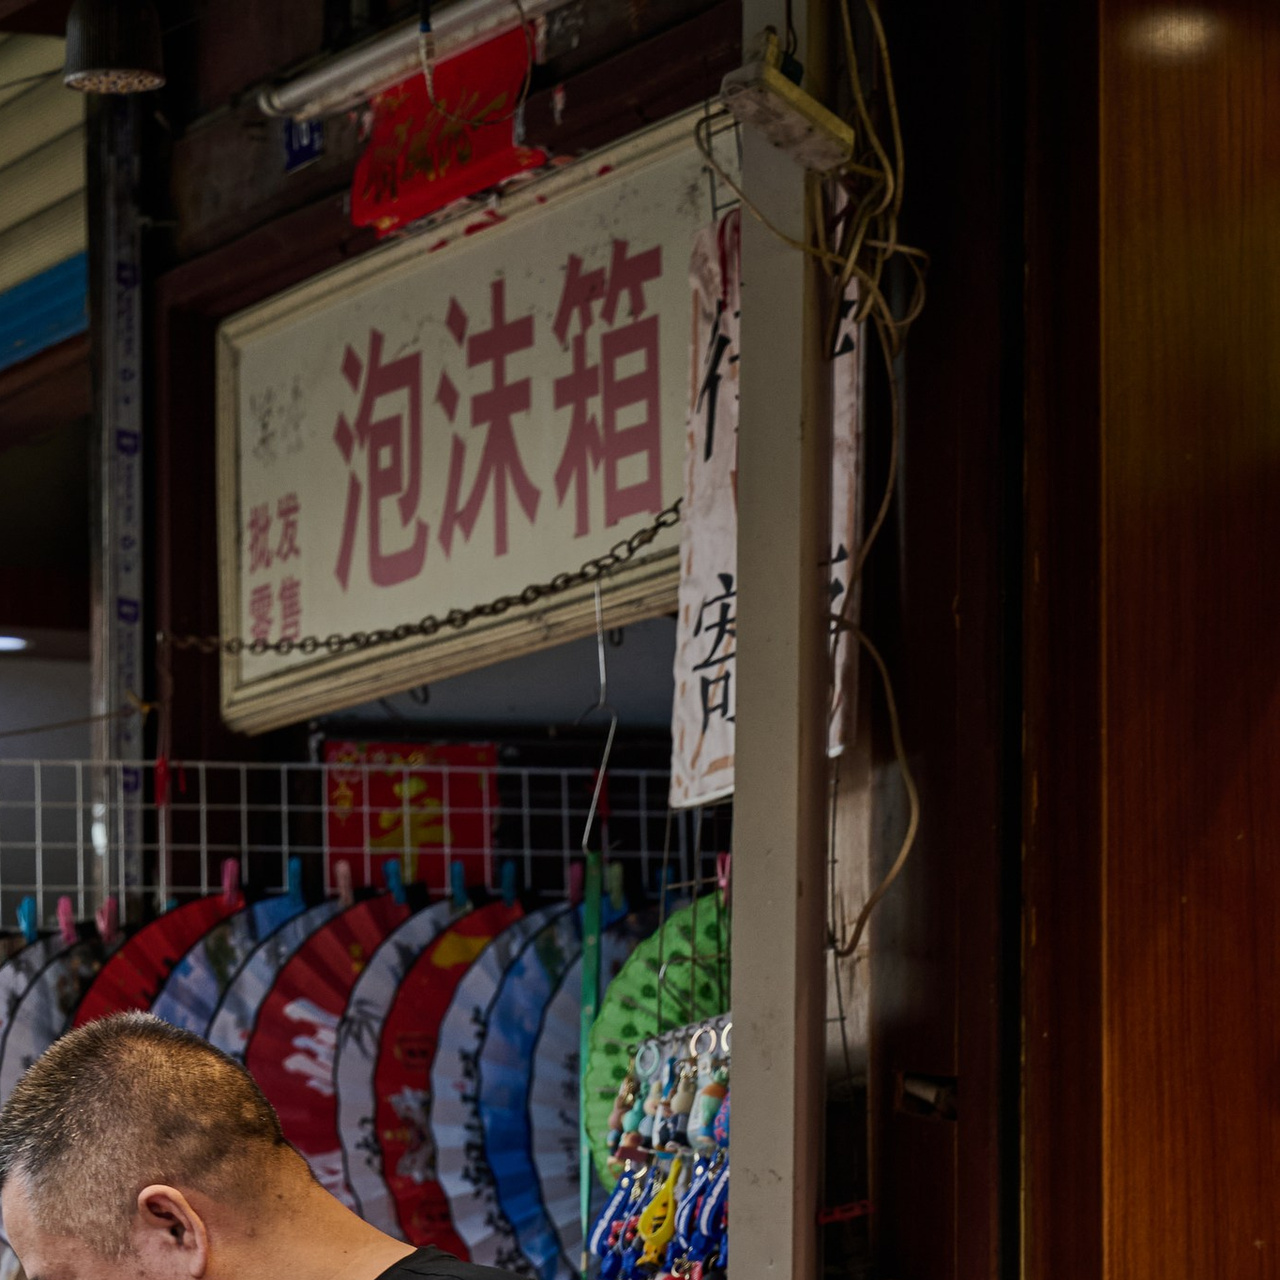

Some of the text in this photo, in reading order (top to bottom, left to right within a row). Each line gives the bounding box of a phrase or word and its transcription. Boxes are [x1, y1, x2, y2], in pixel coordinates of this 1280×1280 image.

[331, 237, 665, 594] 泡沫箱
[247, 491, 302, 575] 批发
[247, 574, 303, 647] 零售
